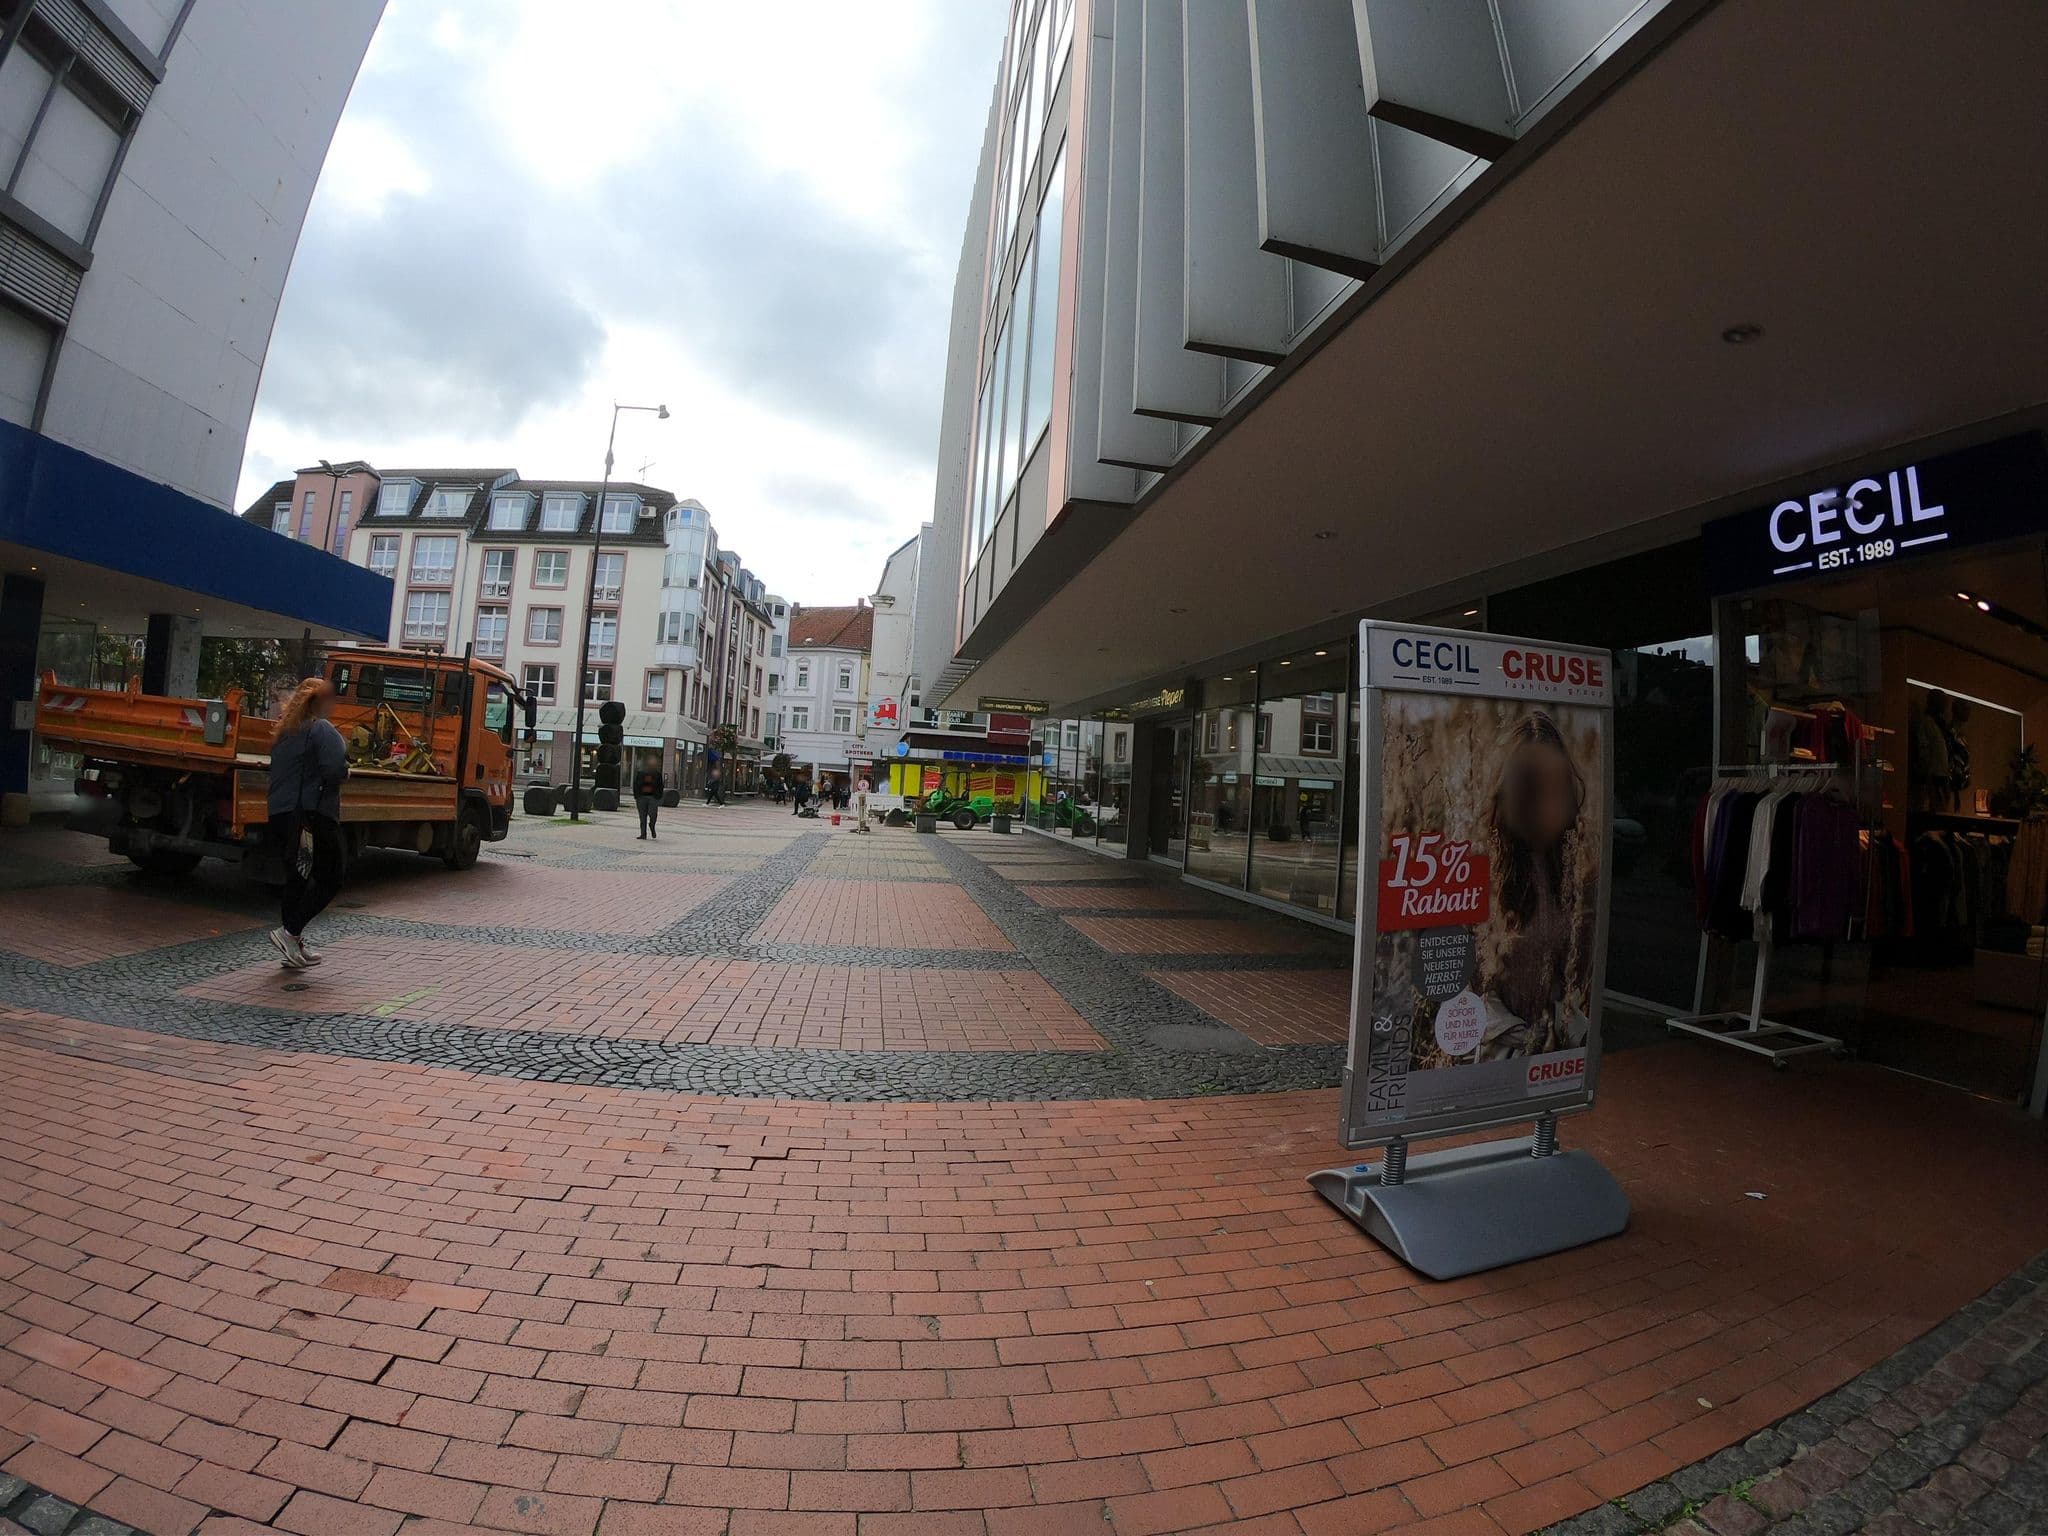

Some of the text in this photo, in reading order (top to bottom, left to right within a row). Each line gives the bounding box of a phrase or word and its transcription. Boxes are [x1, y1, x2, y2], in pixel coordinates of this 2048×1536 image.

[1770, 466, 1945, 553] CECIL
[1818, 538, 1895, 570] EST. 1989
[1393, 638, 1479, 673] CECIL
[1502, 650, 1604, 688] CRUSE
[1438, 677, 1453, 685] 1989
[1504, 680, 1557, 692] fashion
[1387, 834, 1471, 888] 15%
[1420, 934, 1469, 948] ENTDECKEN
[1421, 946, 1467, 960] SIE UNSERE
[1424, 959, 1464, 972] NEUESTEN
[1425, 971, 1462, 986] HERBST-
[1426, 982, 1461, 996] TRENDS
[1448, 1007, 1476, 1018] SOFORT
[1445, 1018, 1478, 1030] UND NUR
[1386, 1013, 1412, 1110] FRIENDS
[1368, 1035, 1392, 1112] FAMILY
[1528, 1057, 1585, 1082] CRUSE
